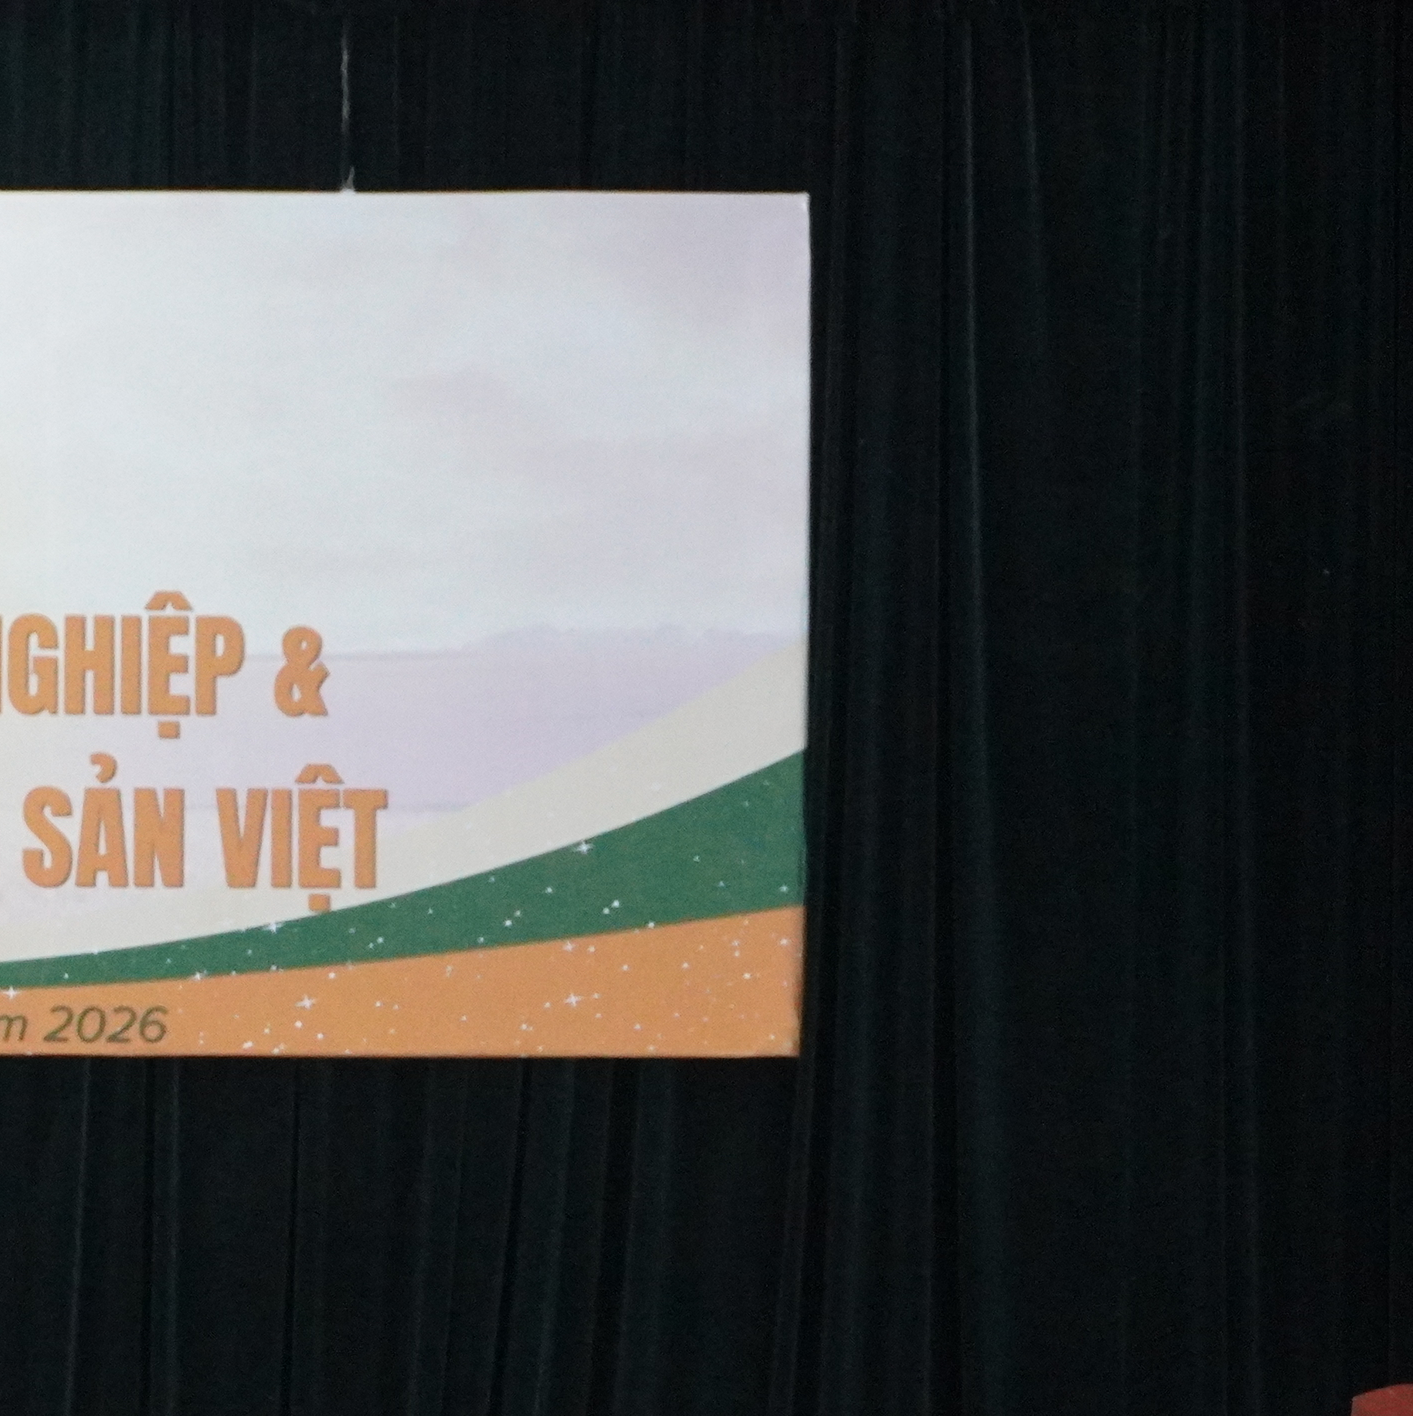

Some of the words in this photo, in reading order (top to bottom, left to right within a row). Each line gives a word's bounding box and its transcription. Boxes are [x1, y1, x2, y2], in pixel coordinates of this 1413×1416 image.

[273, 626, 329, 717] &
[23, 753, 185, 889] SẢN
[216, 764, 389, 913] VIỆT
[43, 1005, 169, 1043] 2026
